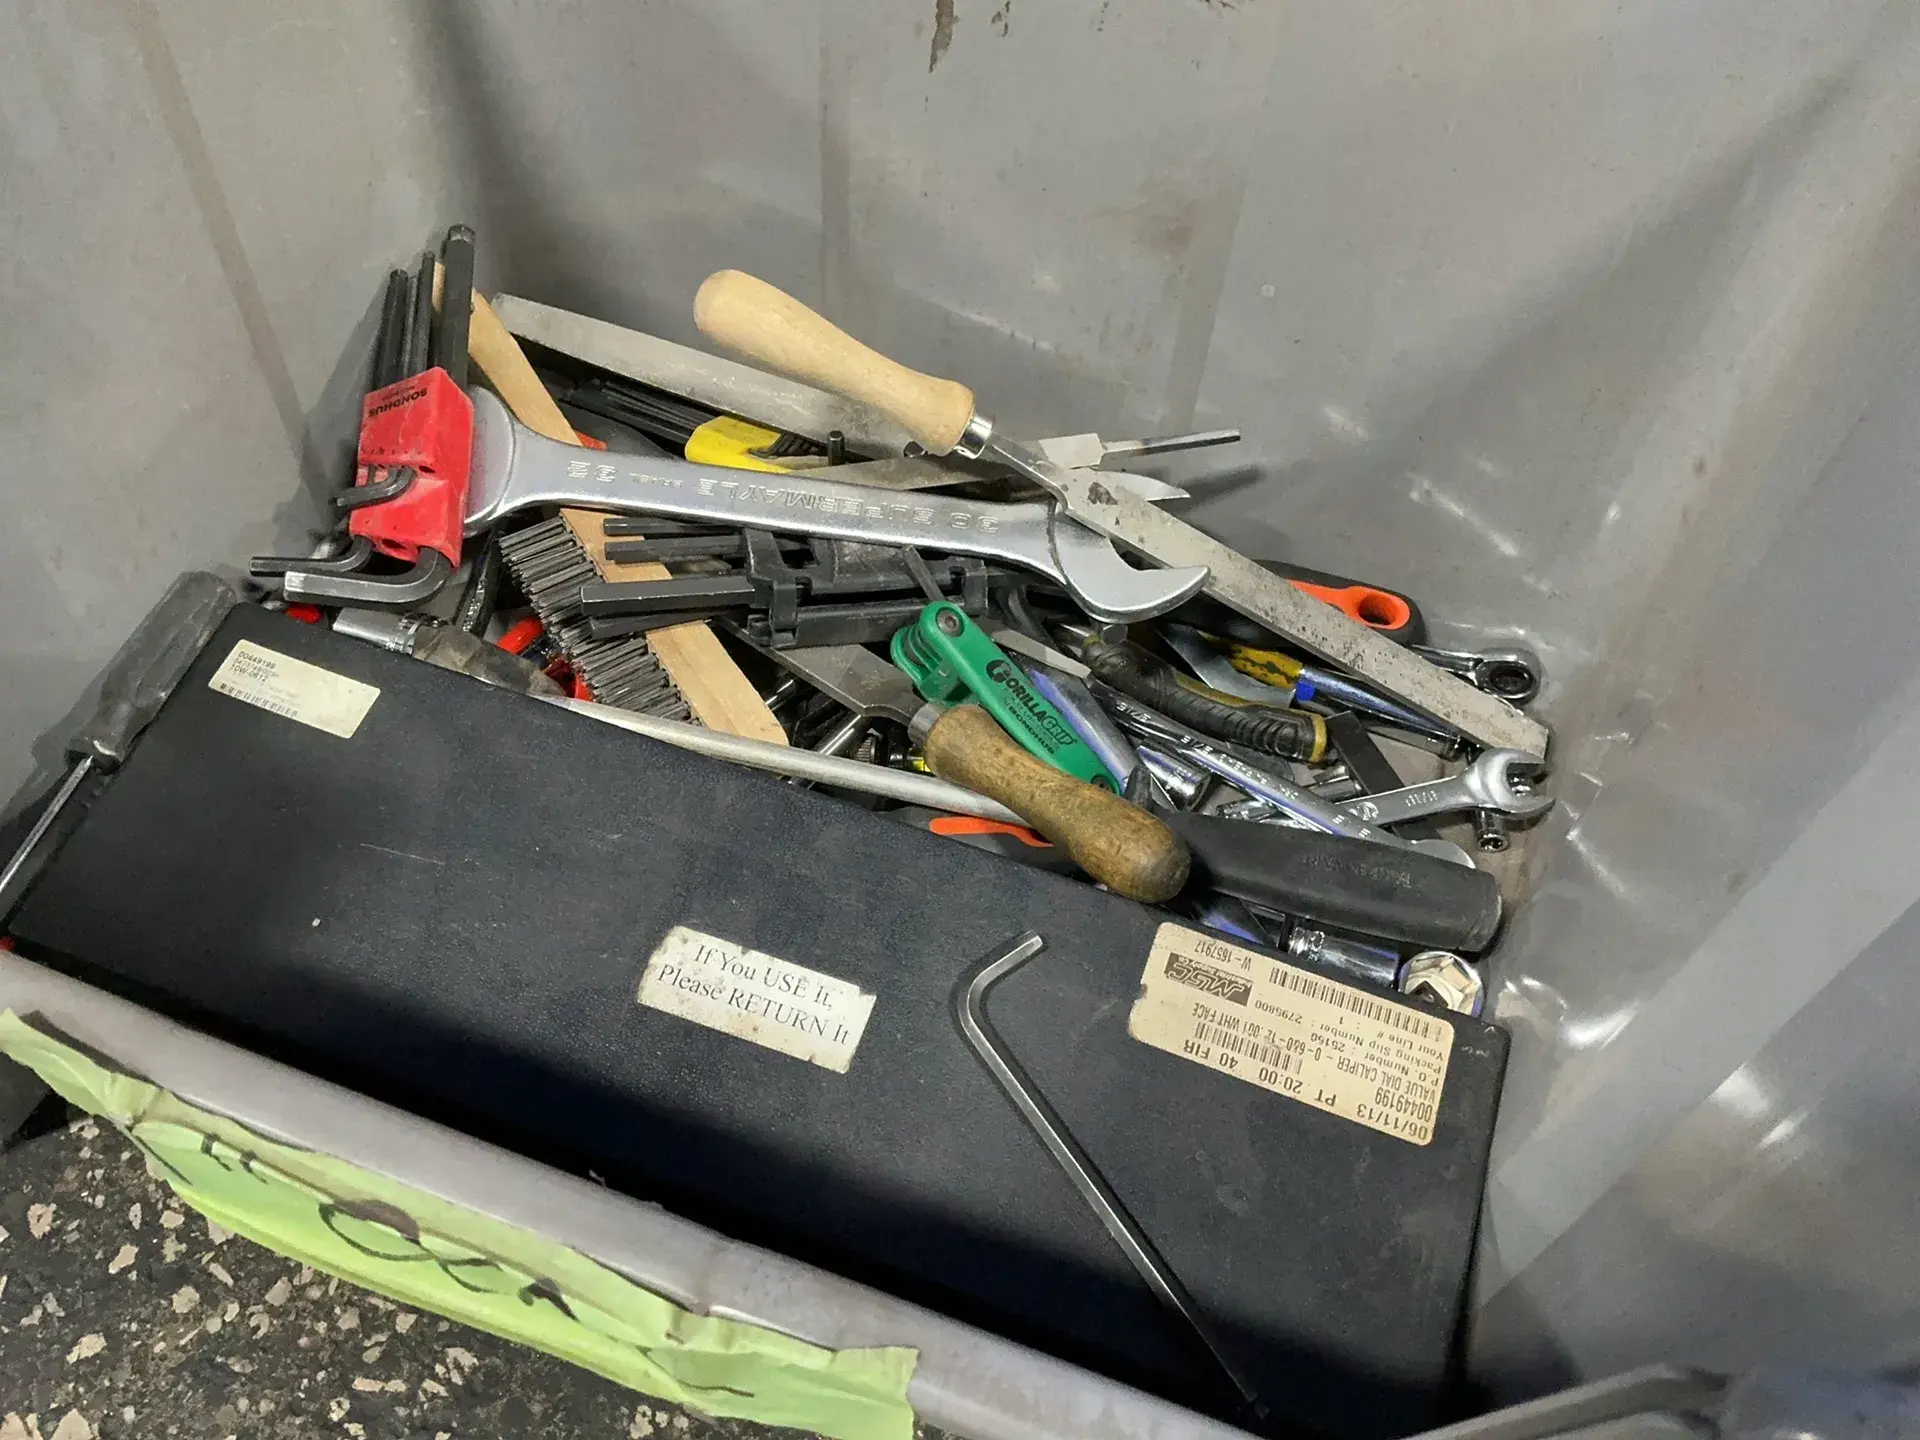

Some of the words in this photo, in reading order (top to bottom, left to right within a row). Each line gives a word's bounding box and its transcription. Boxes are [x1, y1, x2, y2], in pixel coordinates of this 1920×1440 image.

[368, 388, 428, 417] BONDHUS
[1008, 705, 1055, 755] BONDHUS
[693, 944, 717, 965] If
[719, 951, 756, 980] You
[764, 967, 807, 998] USE
[814, 985, 833, 1011] It,
[1190, 960, 1216, 975] Supply
[1216, 969, 1253, 988] Industrial
[1166, 962, 1246, 1001] MSC
[658, 964, 722, 1000] Please
[728, 988, 829, 1036] RETURN
[832, 1024, 850, 1045] It
[1191, 1002, 1217, 1022] FACE
[1254, 1000, 1303, 1025] 2795800
[1217, 1012, 1241, 1030] WHT
[1319, 1023, 1364, 1046] Number
[1388, 1034, 1413, 1050] Line
[1182, 1039, 1211, 1060] FIR
[1368, 1039, 1391, 1056] Slip
[1417, 1044, 1444, 1061] Your
[1218, 1052, 1239, 1070] 40
[1336, 1056, 1378, 1082] CALIPER
[1363, 1052, 1409, 1076] Number
[1394, 1049, 1442, 1074] Packing
[1258, 1067, 1304, 1095] 20:00
[1378, 1071, 1402, 1090] DIAL
[1403, 1080, 1437, 1104] VALUE
[1314, 1088, 1337, 1106] PT
[1373, 1087, 1433, 1123] 00449199
[1355, 1103, 1429, 1141] 06/11/13
